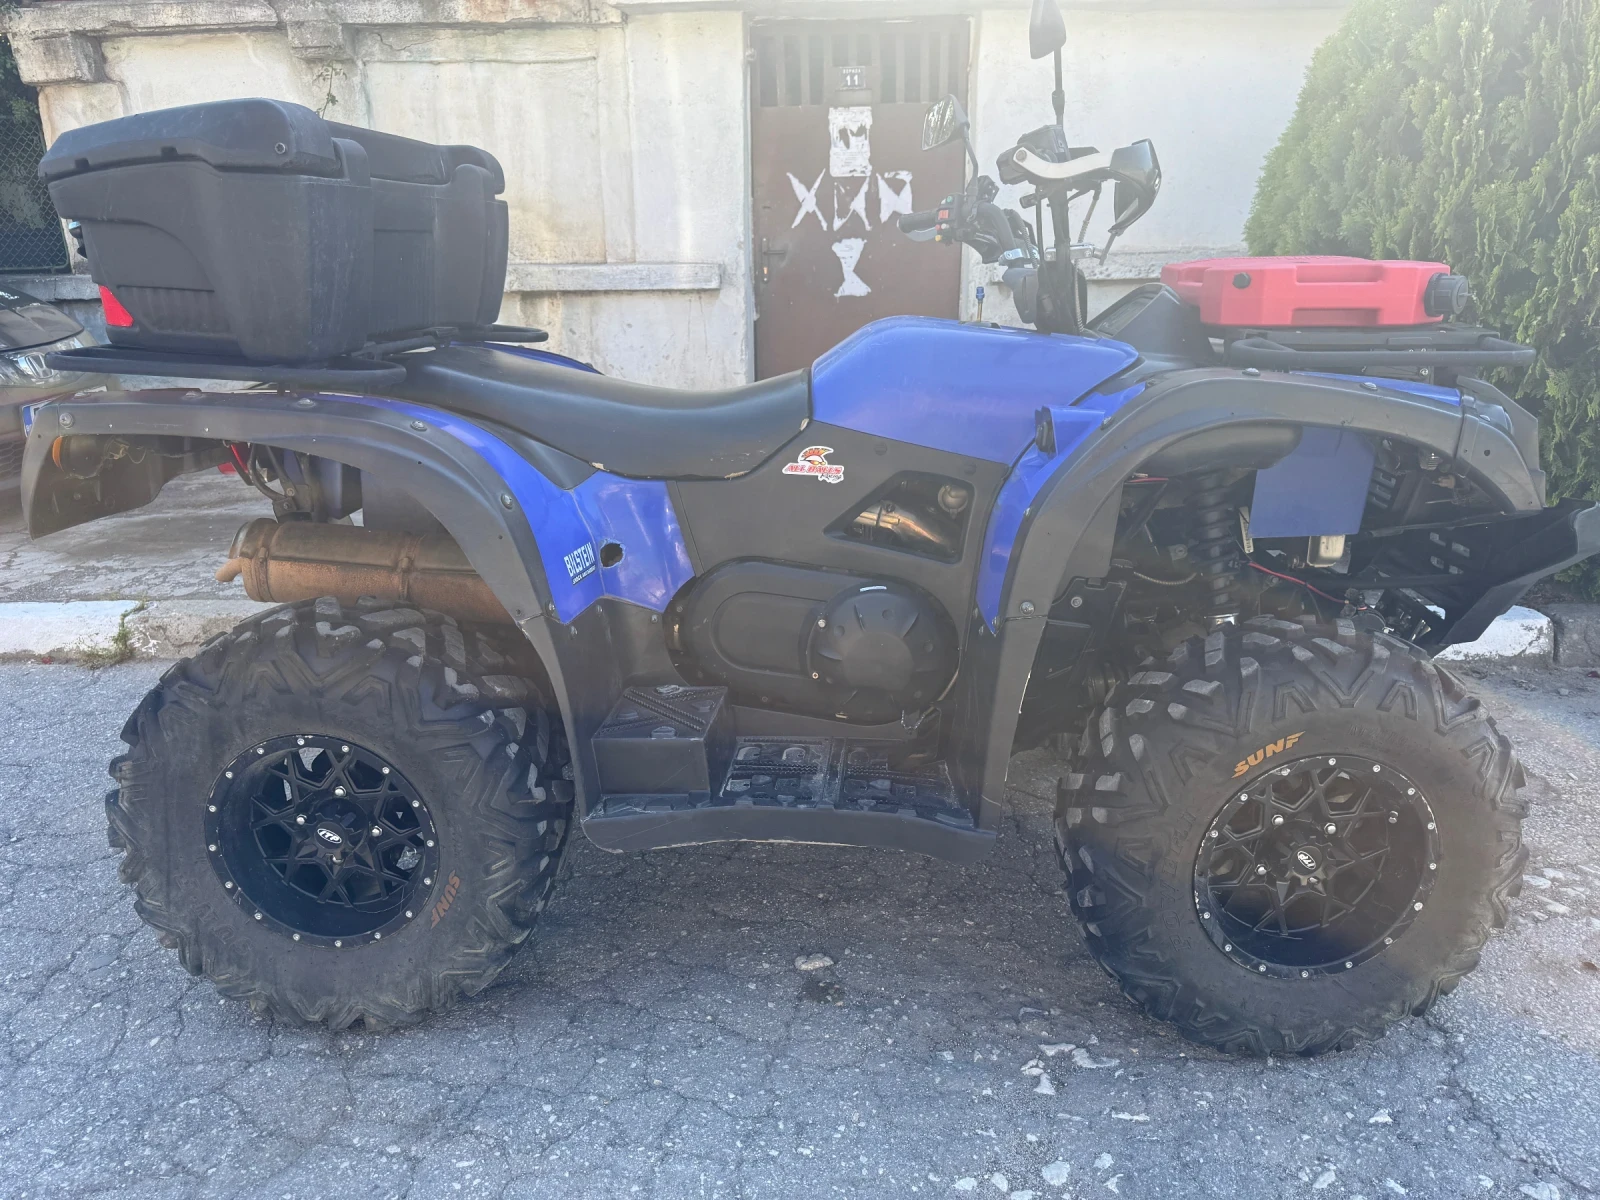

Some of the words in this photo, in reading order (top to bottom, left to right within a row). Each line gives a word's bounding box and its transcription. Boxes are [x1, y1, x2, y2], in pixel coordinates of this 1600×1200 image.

[845, 74, 858, 86] 11
[563, 541, 595, 577] BILSTEIN
[1231, 730, 1306, 779] SUNF
[318, 829, 342, 842] ITP
[430, 869, 460, 930] SUNF
